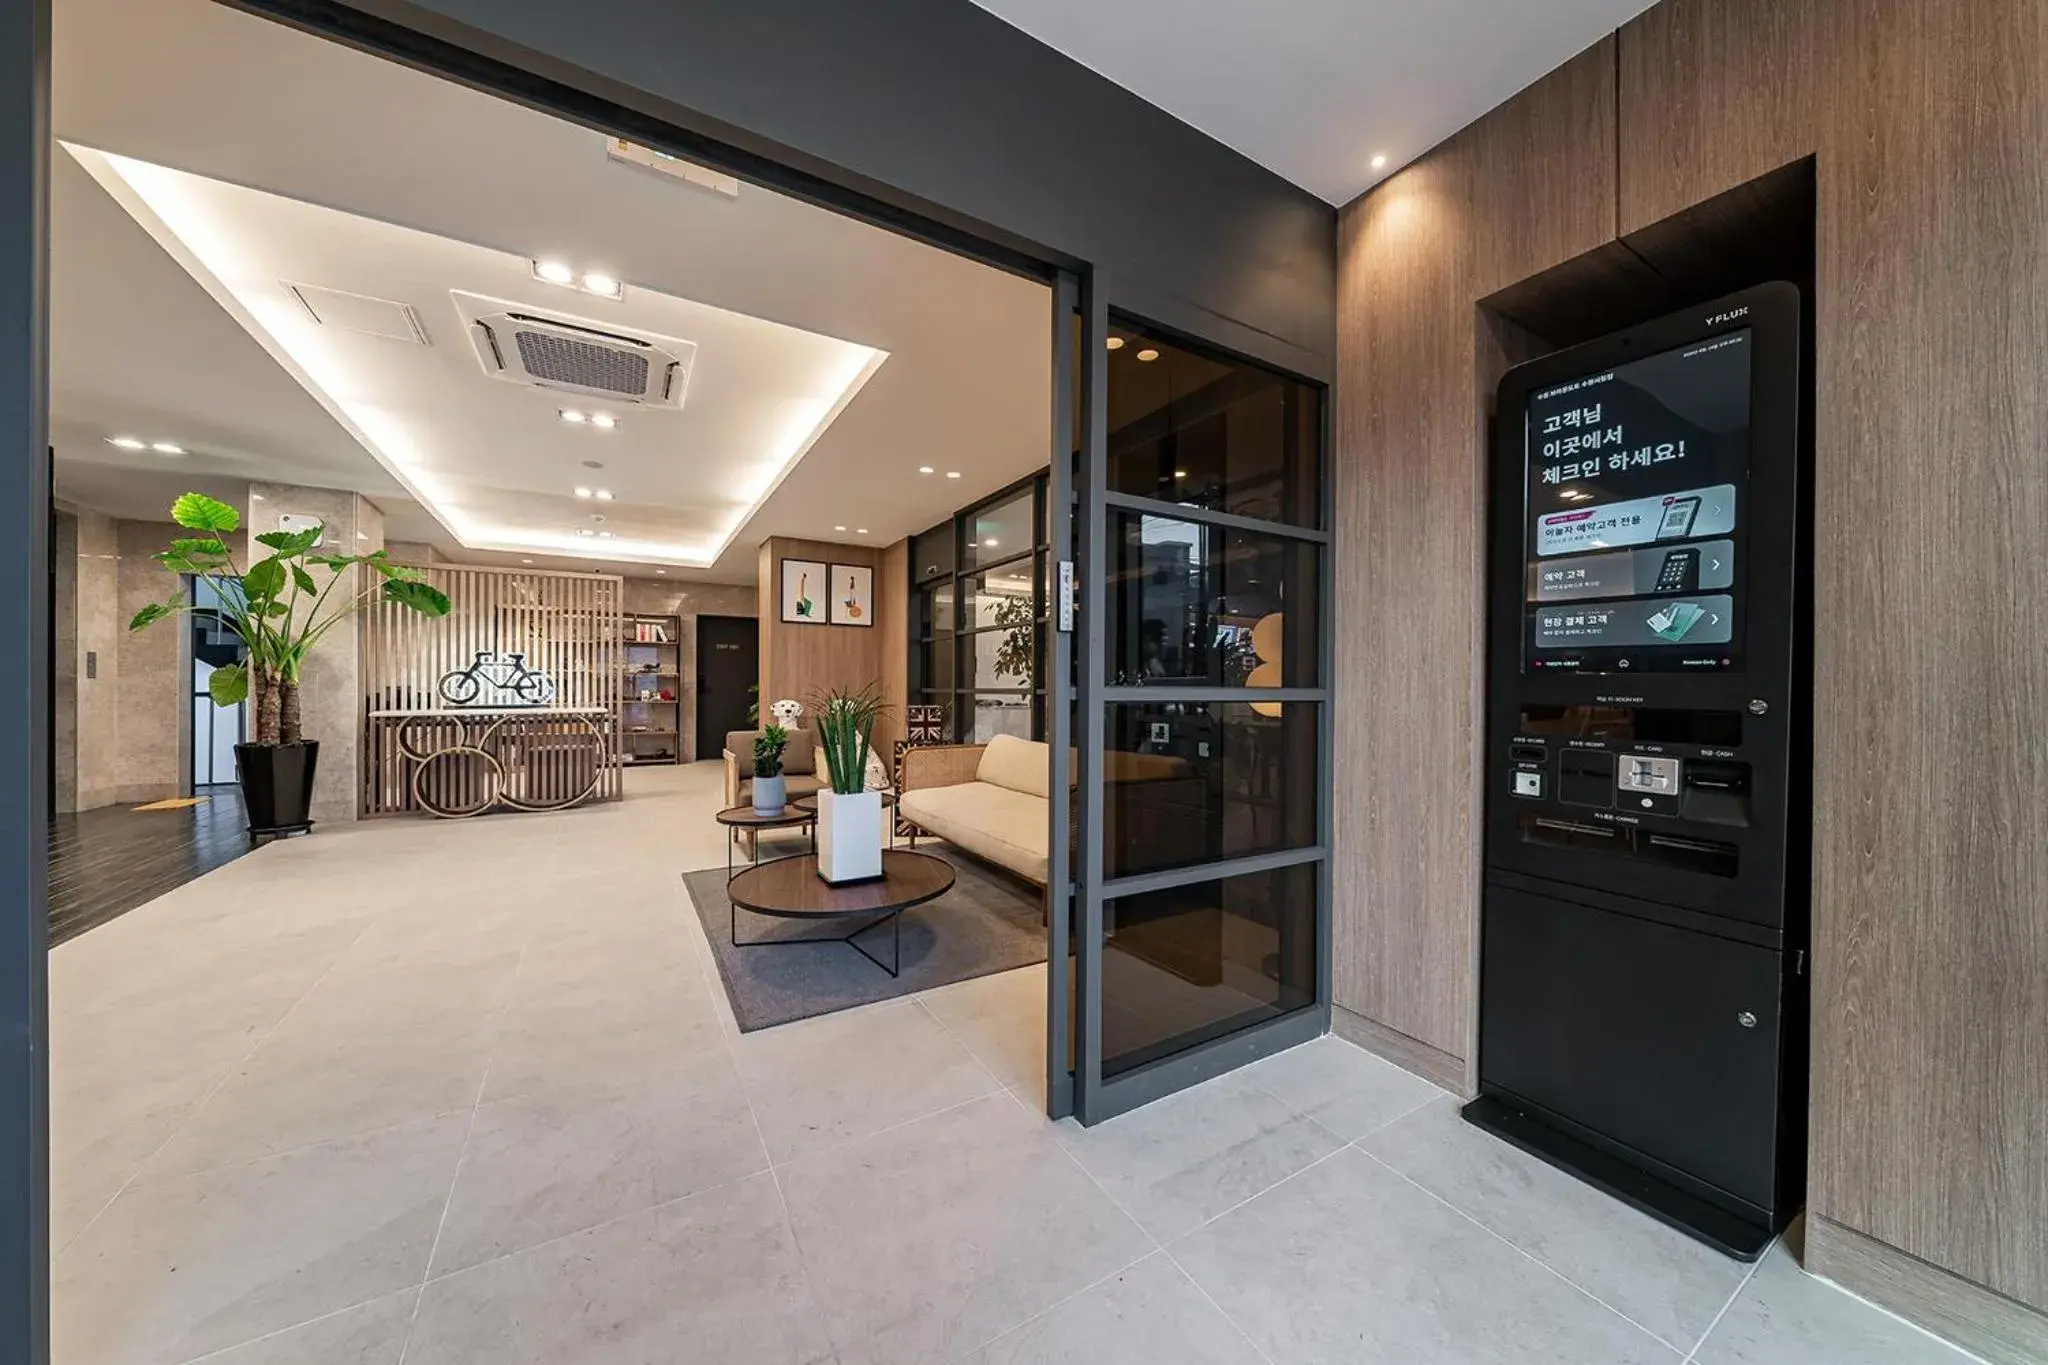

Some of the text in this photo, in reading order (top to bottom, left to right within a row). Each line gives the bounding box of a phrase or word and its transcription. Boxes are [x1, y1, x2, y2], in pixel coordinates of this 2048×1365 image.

[1542, 403, 1601, 434] 고객님
[1542, 425, 1623, 458] 이곳에서
[1541, 440, 1686, 484] 체크인 하세요!
